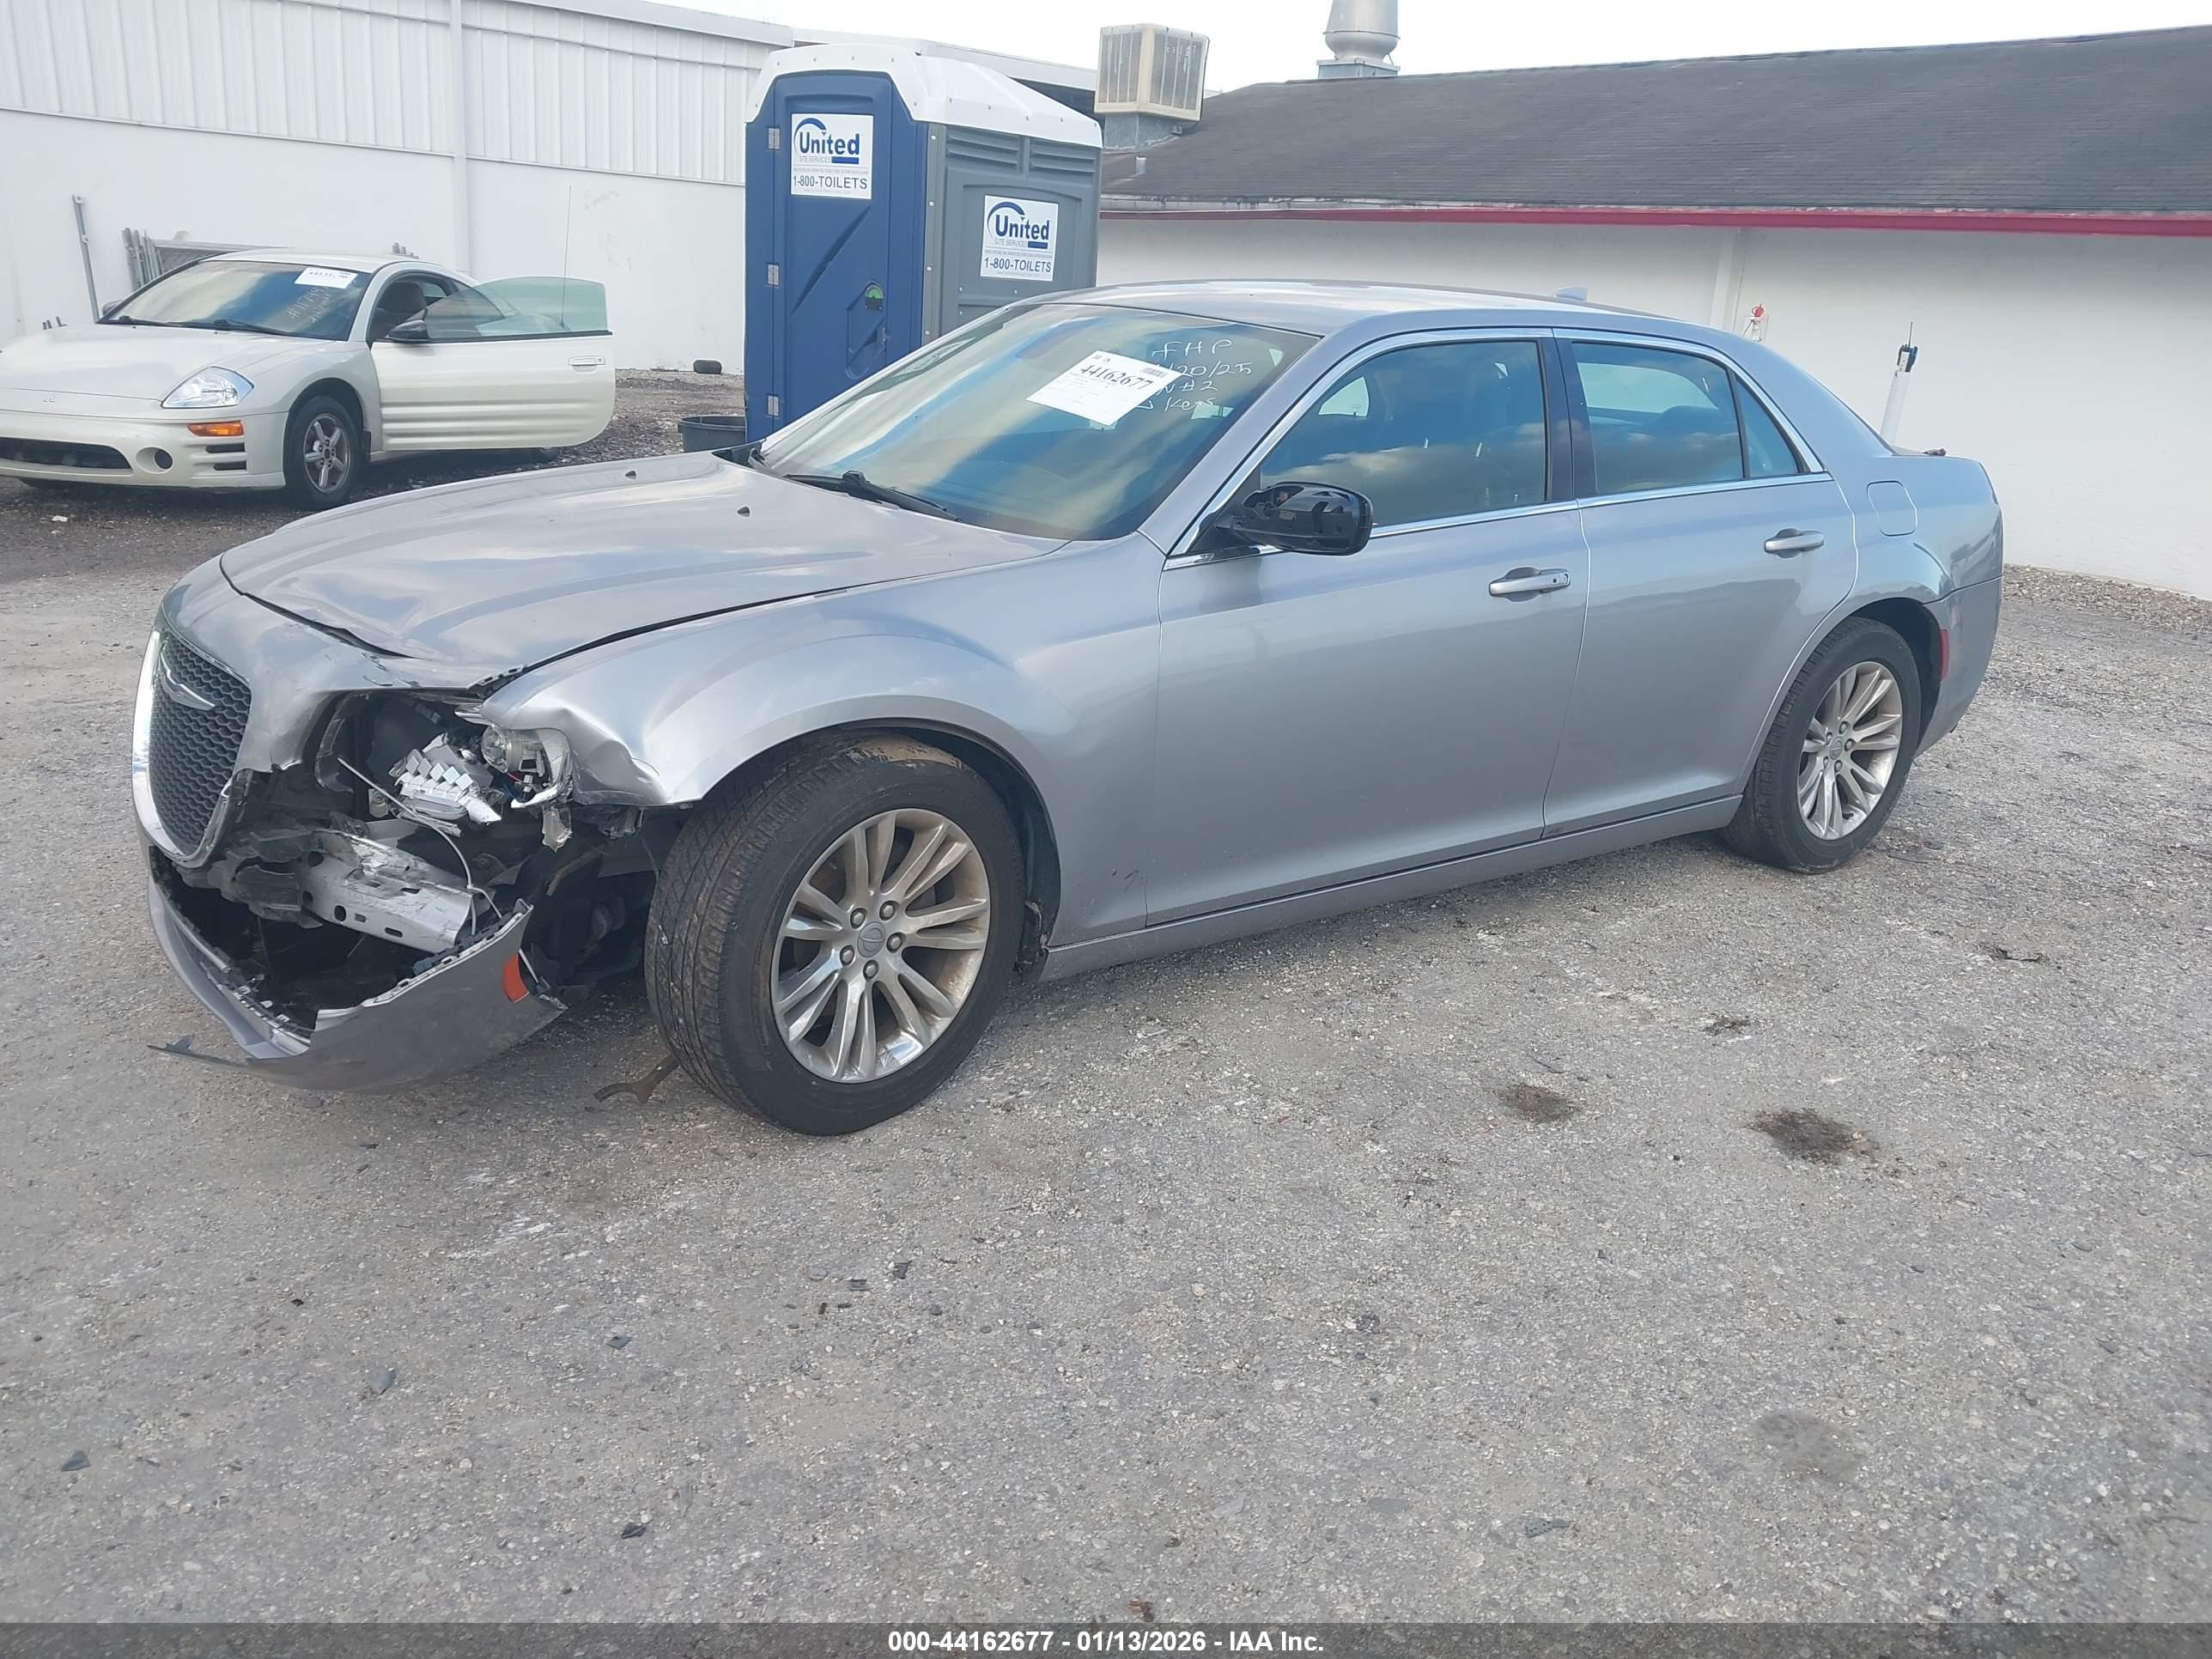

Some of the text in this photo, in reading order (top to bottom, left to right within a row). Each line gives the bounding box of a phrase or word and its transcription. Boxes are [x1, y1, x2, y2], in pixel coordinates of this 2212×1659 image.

[799, 131, 860, 155] United
[793, 174, 867, 190] 1-800-TOILETS
[995, 214, 1050, 240] United
[1006, 240, 1027, 248] SERVICES
[984, 257, 1052, 273] 1-800-TOILETS
[1079, 364, 1154, 390] 44162677
